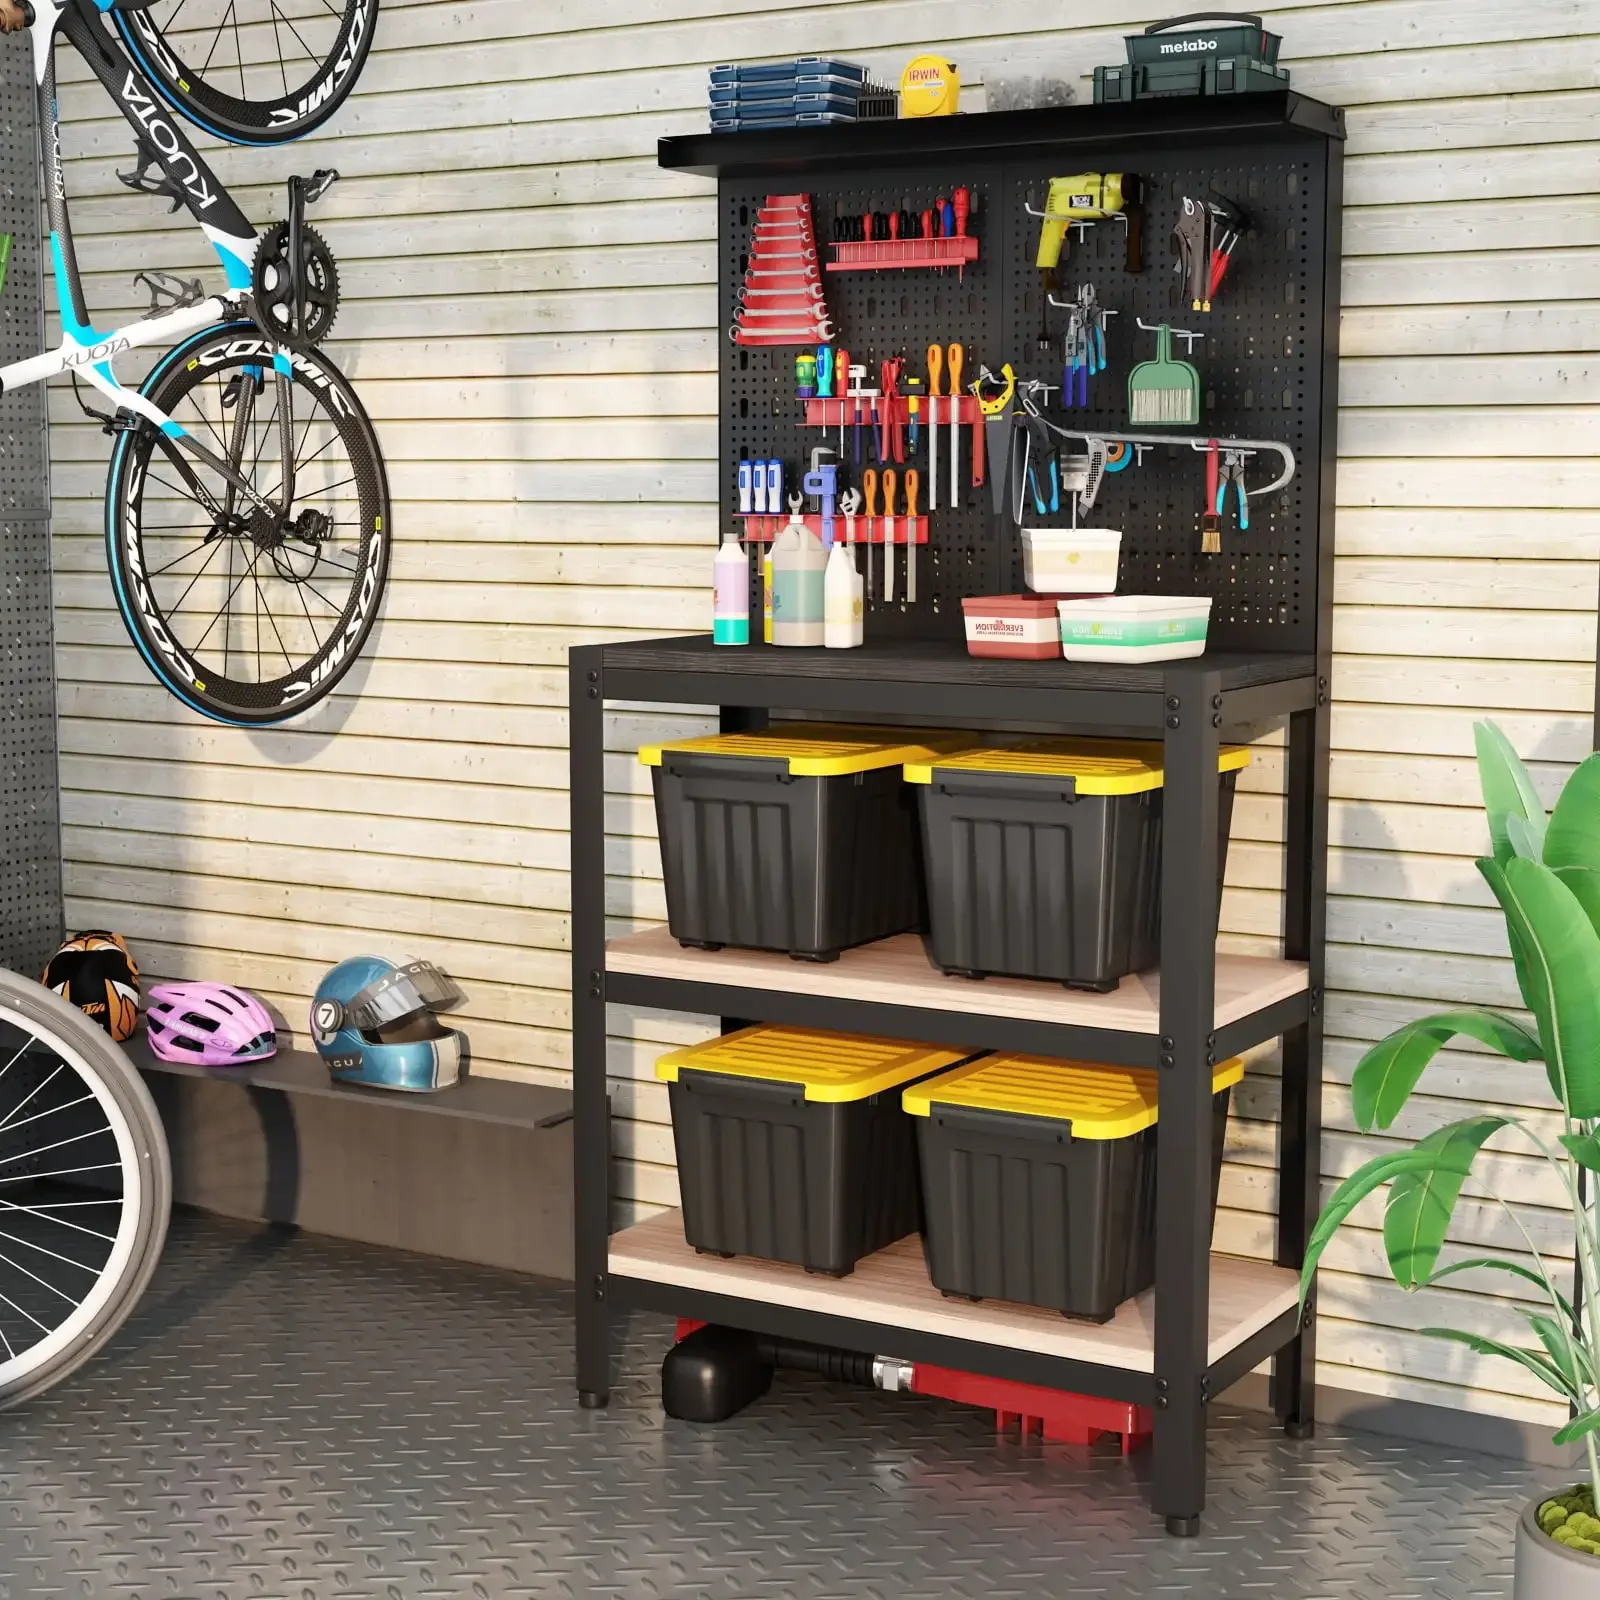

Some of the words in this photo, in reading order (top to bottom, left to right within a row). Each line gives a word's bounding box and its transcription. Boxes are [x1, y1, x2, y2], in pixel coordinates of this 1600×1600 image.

[1160, 38, 1218, 54] metabo
[909, 67, 940, 82] IRWIN
[122, 69, 218, 210] KUOTA
[61, 337, 130, 370] KUOTA
[245, 485, 276, 519] KUOTA
[321, 1008, 333, 1025] 7
